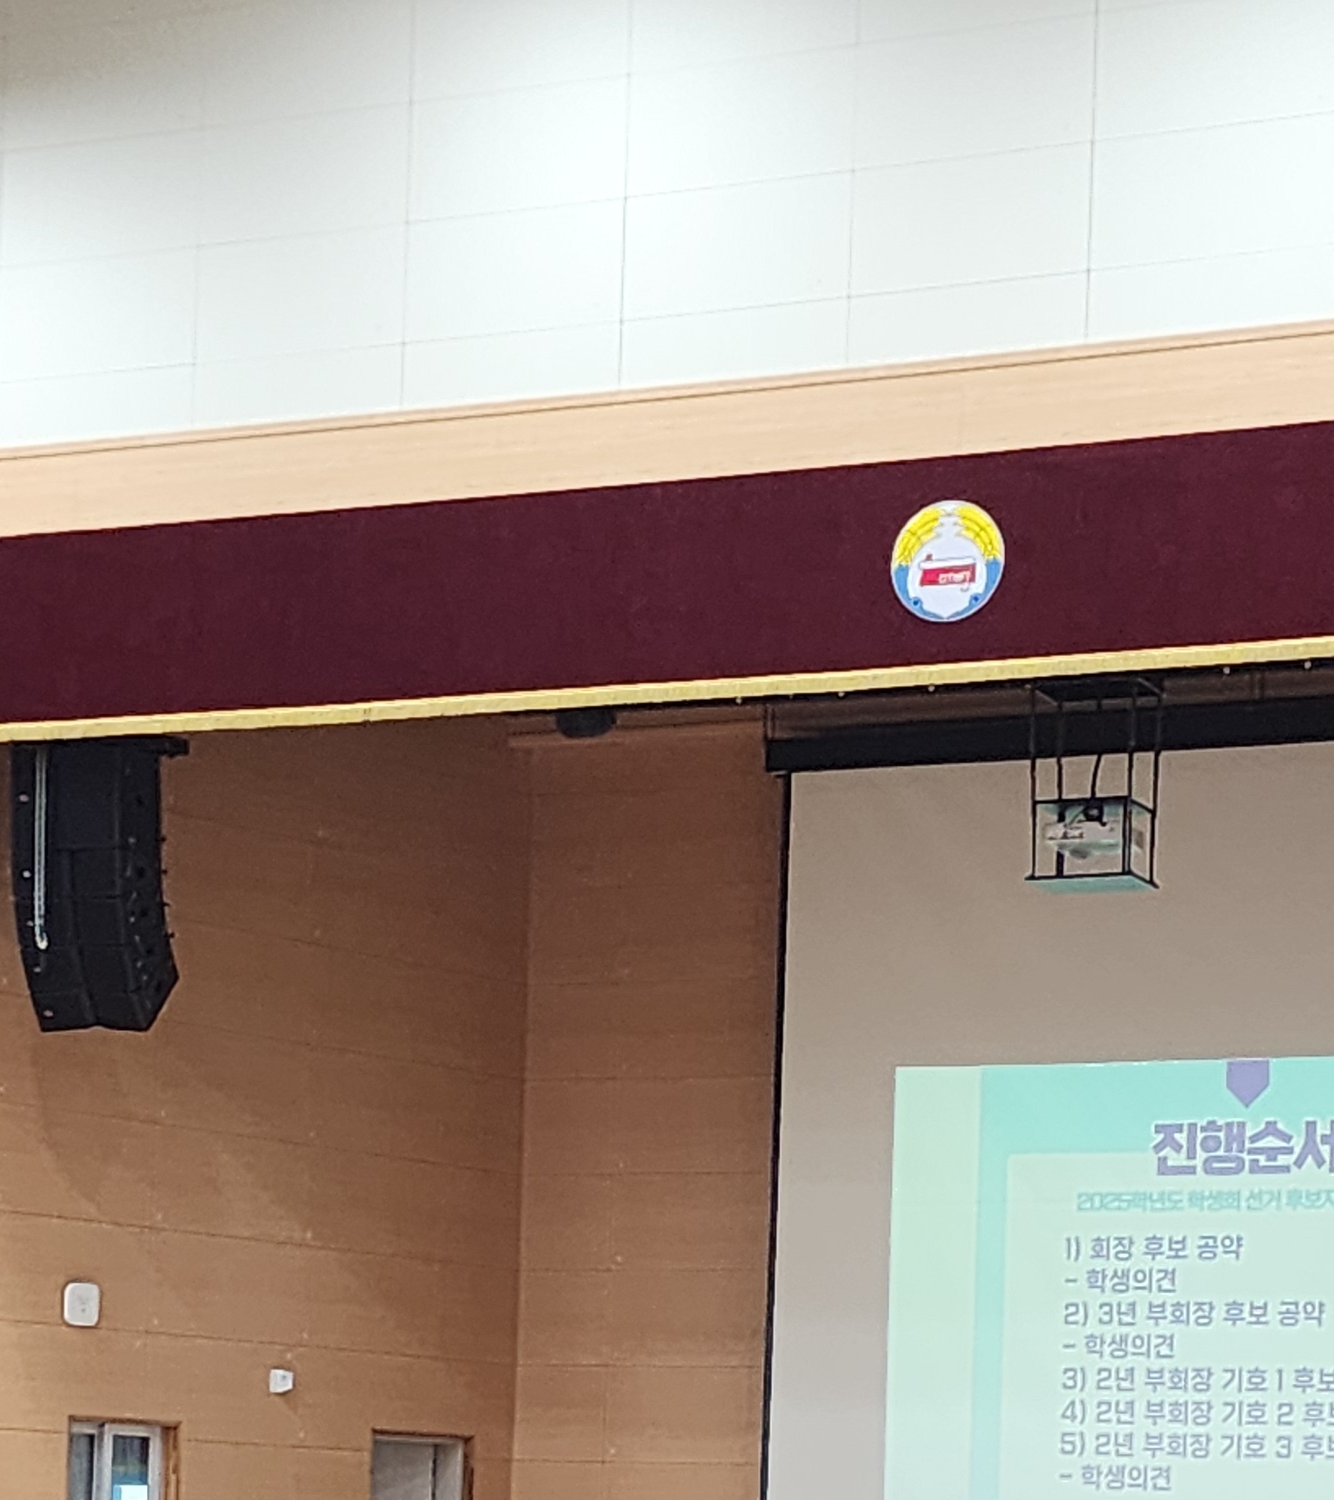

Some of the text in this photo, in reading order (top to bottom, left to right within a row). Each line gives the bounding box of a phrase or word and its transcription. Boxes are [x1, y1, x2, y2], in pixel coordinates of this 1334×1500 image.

[1188, 1189, 1241, 1213] 학생회
[1246, 1188, 1282, 1212] 선거
[1066, 1234, 1243, 1262] 1) 회장 후보 공약
[1086, 1267, 1177, 1293] 학생의견
[1064, 1300, 1326, 1328] 2) 3년 부회장 후보 공약
[1084, 1332, 1175, 1359] 학생의견
[1062, 1366, 1086, 1393] 3)
[1096, 1366, 1135, 1392] 2년
[1144, 1366, 1212, 1394] 부회장
[1221, 1367, 1268, 1394] 기호
[1061, 1399, 1086, 1426] 4)
[1096, 1399, 1135, 1426] 2년
[1144, 1399, 1212, 1427] 부회장
[1221, 1399, 1268, 1427] 기호
[1277, 1403, 1294, 1426] 2
[1059, 1431, 1086, 1457] 5)
[1094, 1431, 1134, 1458] 2년
[1143, 1431, 1212, 1459] 부회장
[1220, 1432, 1268, 1460] 기호
[1275, 1436, 1292, 1459] 3
[1081, 1463, 1172, 1491] 학생의견
